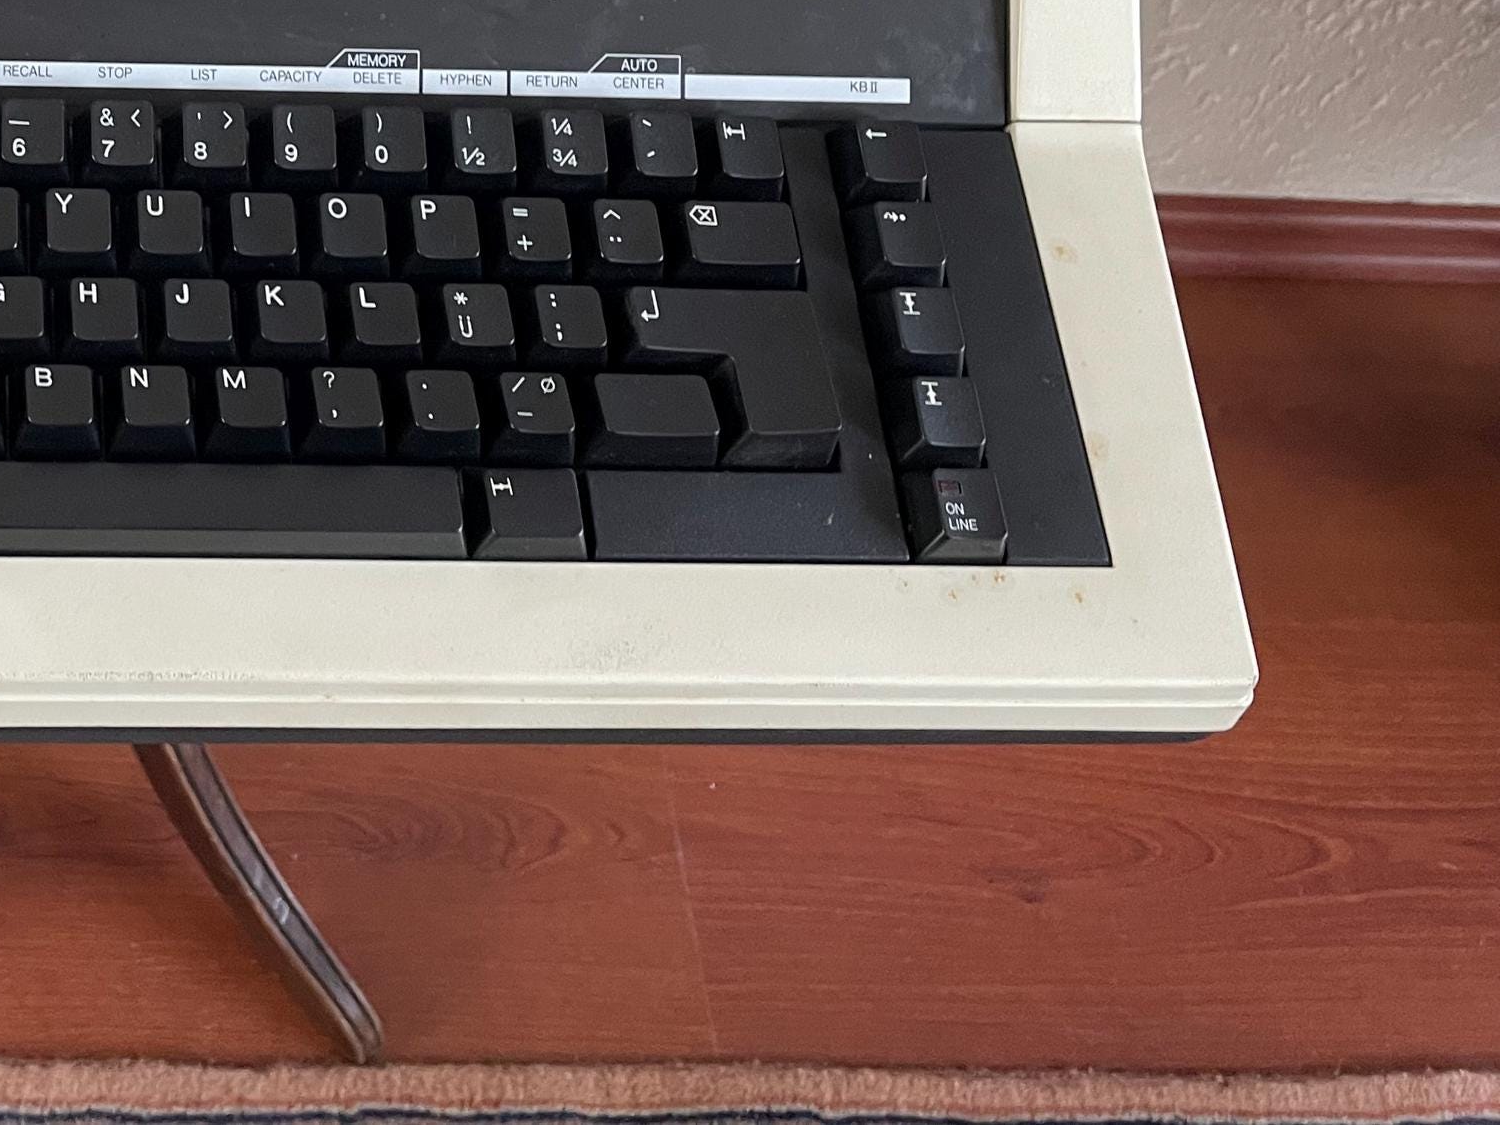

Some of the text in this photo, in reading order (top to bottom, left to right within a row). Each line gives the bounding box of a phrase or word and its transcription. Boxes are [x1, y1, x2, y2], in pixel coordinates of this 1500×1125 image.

[347, 54, 406, 68] MEMORY
[621, 59, 657, 72] AUTO
[3, 65, 52, 78] RECALL
[98, 66, 132, 79] STOP
[191, 68, 217, 81] LIST
[259, 70, 322, 83] CAPACITY
[353, 72, 401, 84] DELETE
[440, 74, 492, 87] HYPHEN
[526, 75, 664, 89] RETURN CENTER
[100, 109, 114, 126] &
[12, 138, 26, 157] 6
[101, 140, 115, 158] 7
[194, 142, 207, 160] 8
[284, 143, 298, 161] 9
[54, 193, 74, 214] Y
[146, 195, 163, 216] U
[244, 196, 250, 217] I
[328, 198, 347, 219] O
[420, 200, 436, 220] P
[517, 234, 533, 251] +
[79, 283, 97, 303] H
[175, 284, 189, 304] J
[264, 285, 285, 306] K
[359, 287, 376, 308] L
[35, 367, 53, 388] B
[130, 368, 149, 388] N
[222, 369, 247, 389] M
[945, 502, 964, 515] ON
[949, 517, 978, 531] LINE
